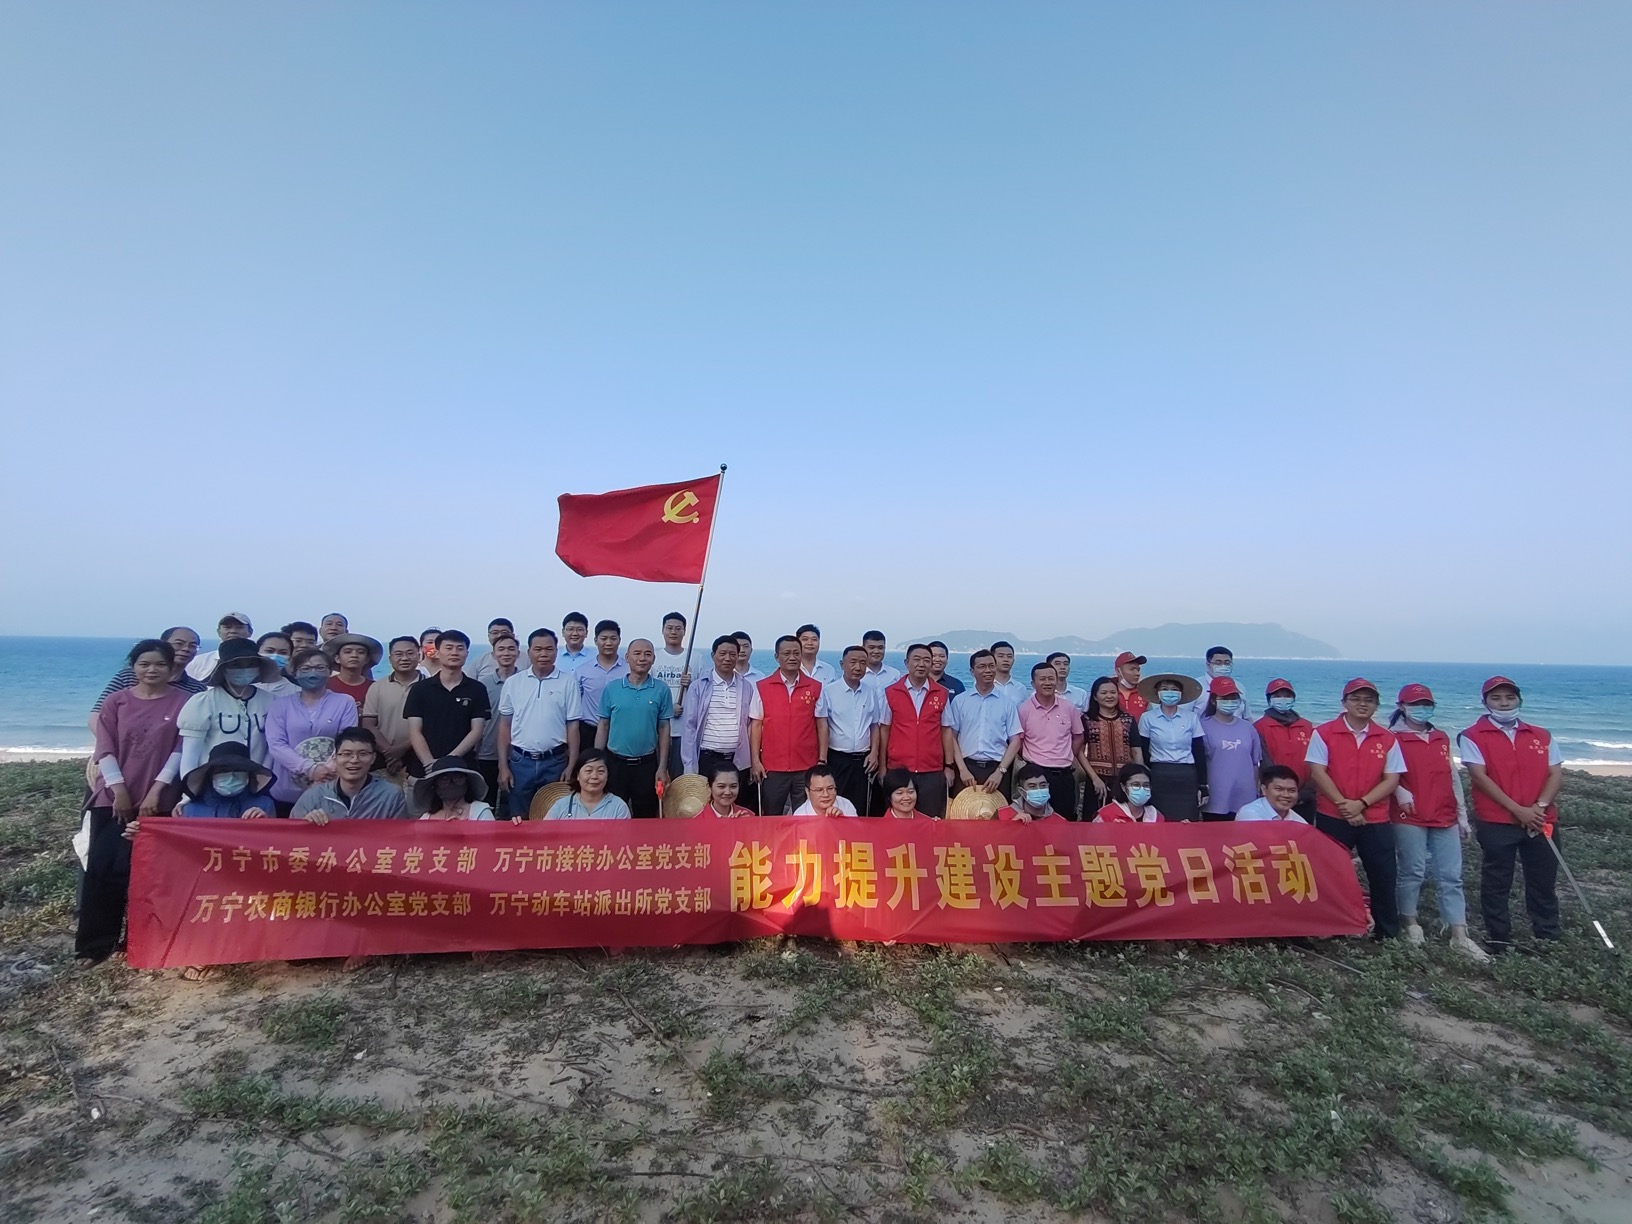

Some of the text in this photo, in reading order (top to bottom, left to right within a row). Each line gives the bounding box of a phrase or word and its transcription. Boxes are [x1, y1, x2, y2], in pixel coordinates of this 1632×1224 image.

[203, 843, 711, 874] 万宁市委办公室党支部 万宁市接待办公室党支部
[727, 838, 1319, 911] 能力提升建设主题党日活动
[190, 886, 711, 924] 万宁农商银行办公室党支部 万宁动车站派出所党支部
